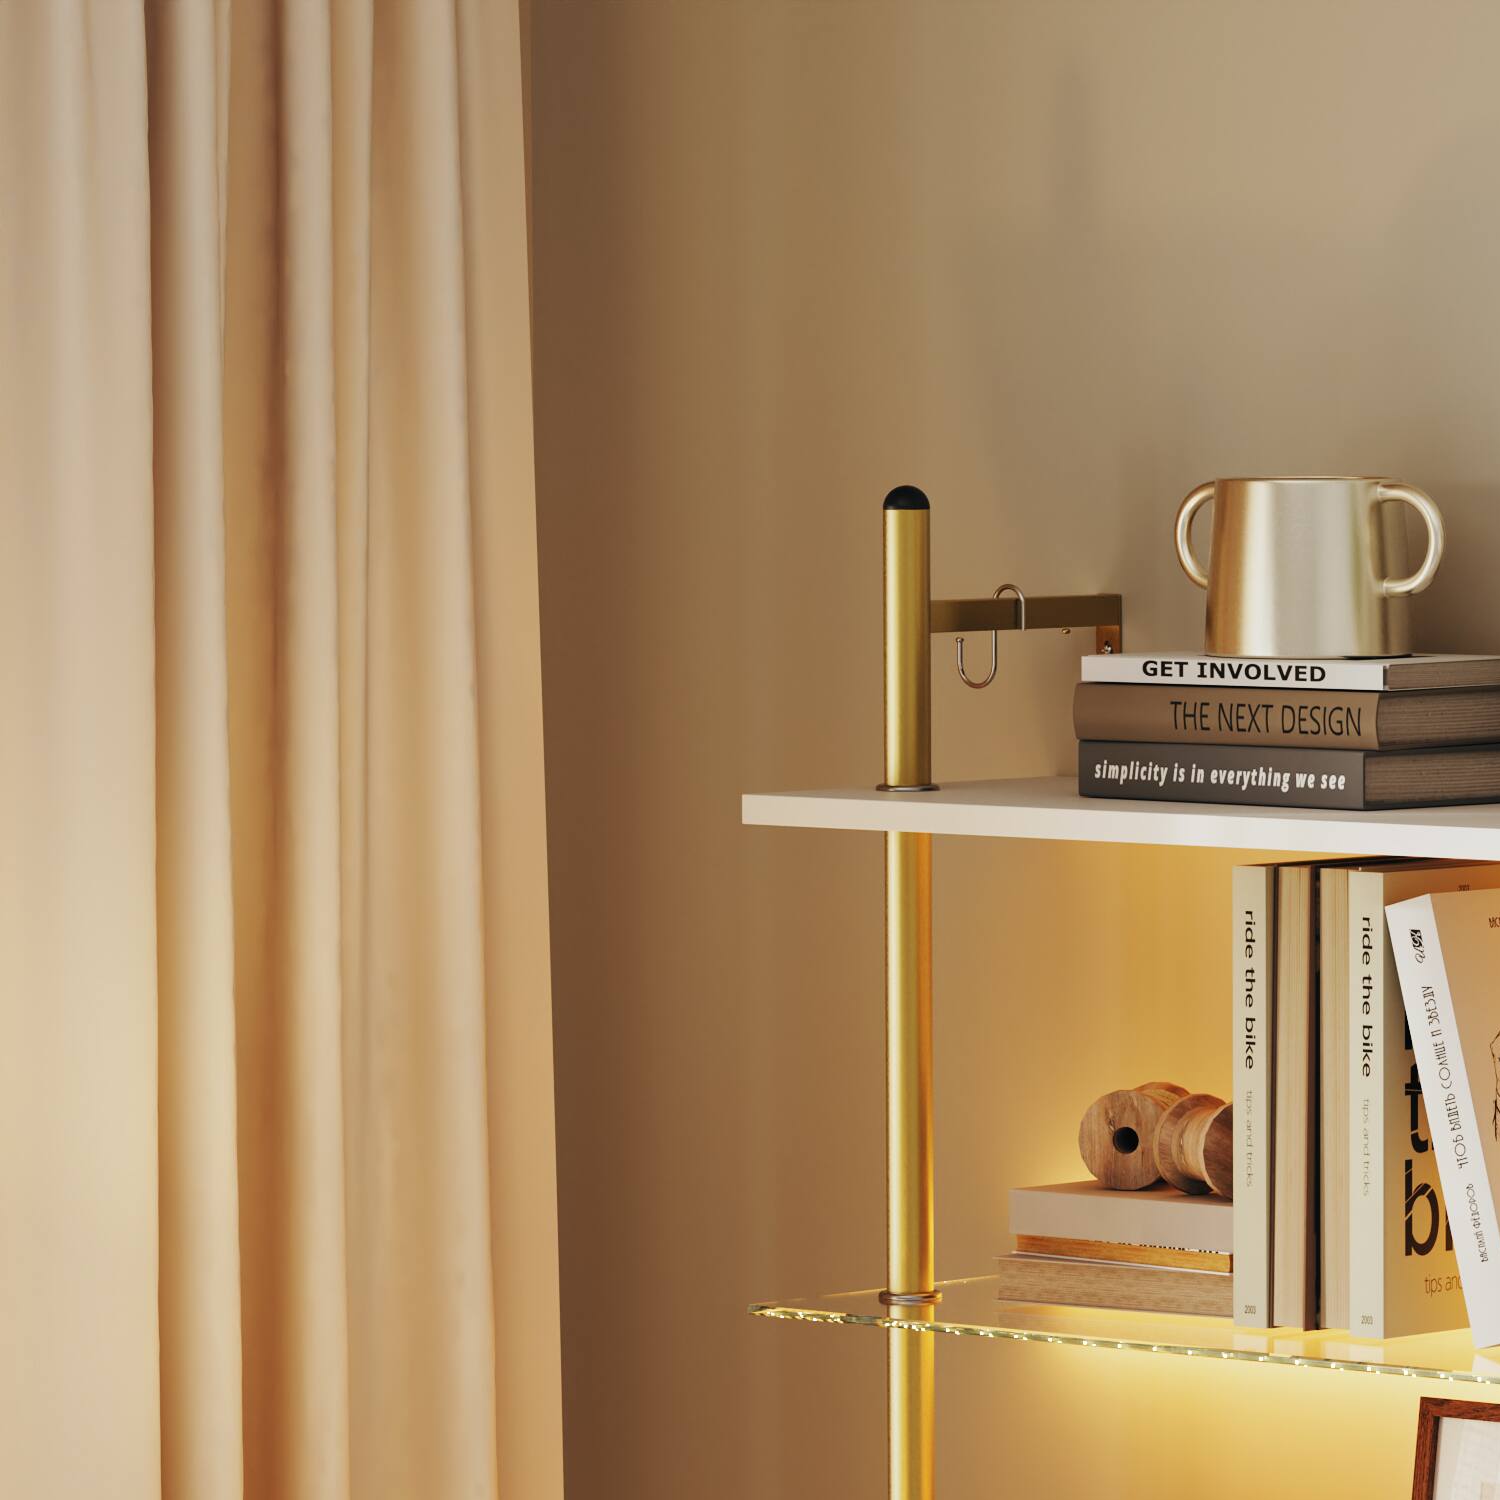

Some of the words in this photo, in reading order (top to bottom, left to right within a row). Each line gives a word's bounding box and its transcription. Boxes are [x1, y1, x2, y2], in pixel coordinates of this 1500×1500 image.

[1142, 659, 1188, 678] GET
[1196, 662, 1327, 682] INVOLVED
[1170, 700, 1211, 732] THE
[1218, 702, 1274, 734] NEXT
[1282, 705, 1362, 737] DESIGN
[1094, 760, 1168, 786] simplicity
[1172, 762, 1186, 783] is
[1190, 764, 1205, 785] in
[1210, 766, 1290, 793] everything
[1295, 772, 1316, 790] we
[1321, 773, 1346, 791] see
[1245, 909, 1256, 958] ride
[1361, 915, 1372, 966] ride
[1244, 967, 1256, 1008] the
[1361, 973, 1372, 1016] the
[1422, 986, 1441, 1027] ЗВЕЗДУ
[1245, 1016, 1257, 1070] bike
[1361, 1023, 1372, 1078] bike
[1433, 1041, 1452, 1089] СОЛНЦЕ
[1245, 1090, 1253, 1116] tips
[1362, 1099, 1370, 1124] tips
[1444, 1094, 1462, 1132] ВИДЕТЬ
[1245, 1152, 1254, 1187] tricks
[1452, 1134, 1469, 1169] ЧТОБ
[1362, 1160, 1371, 1197] tricks
[1424, 1274, 1443, 1297] tips
